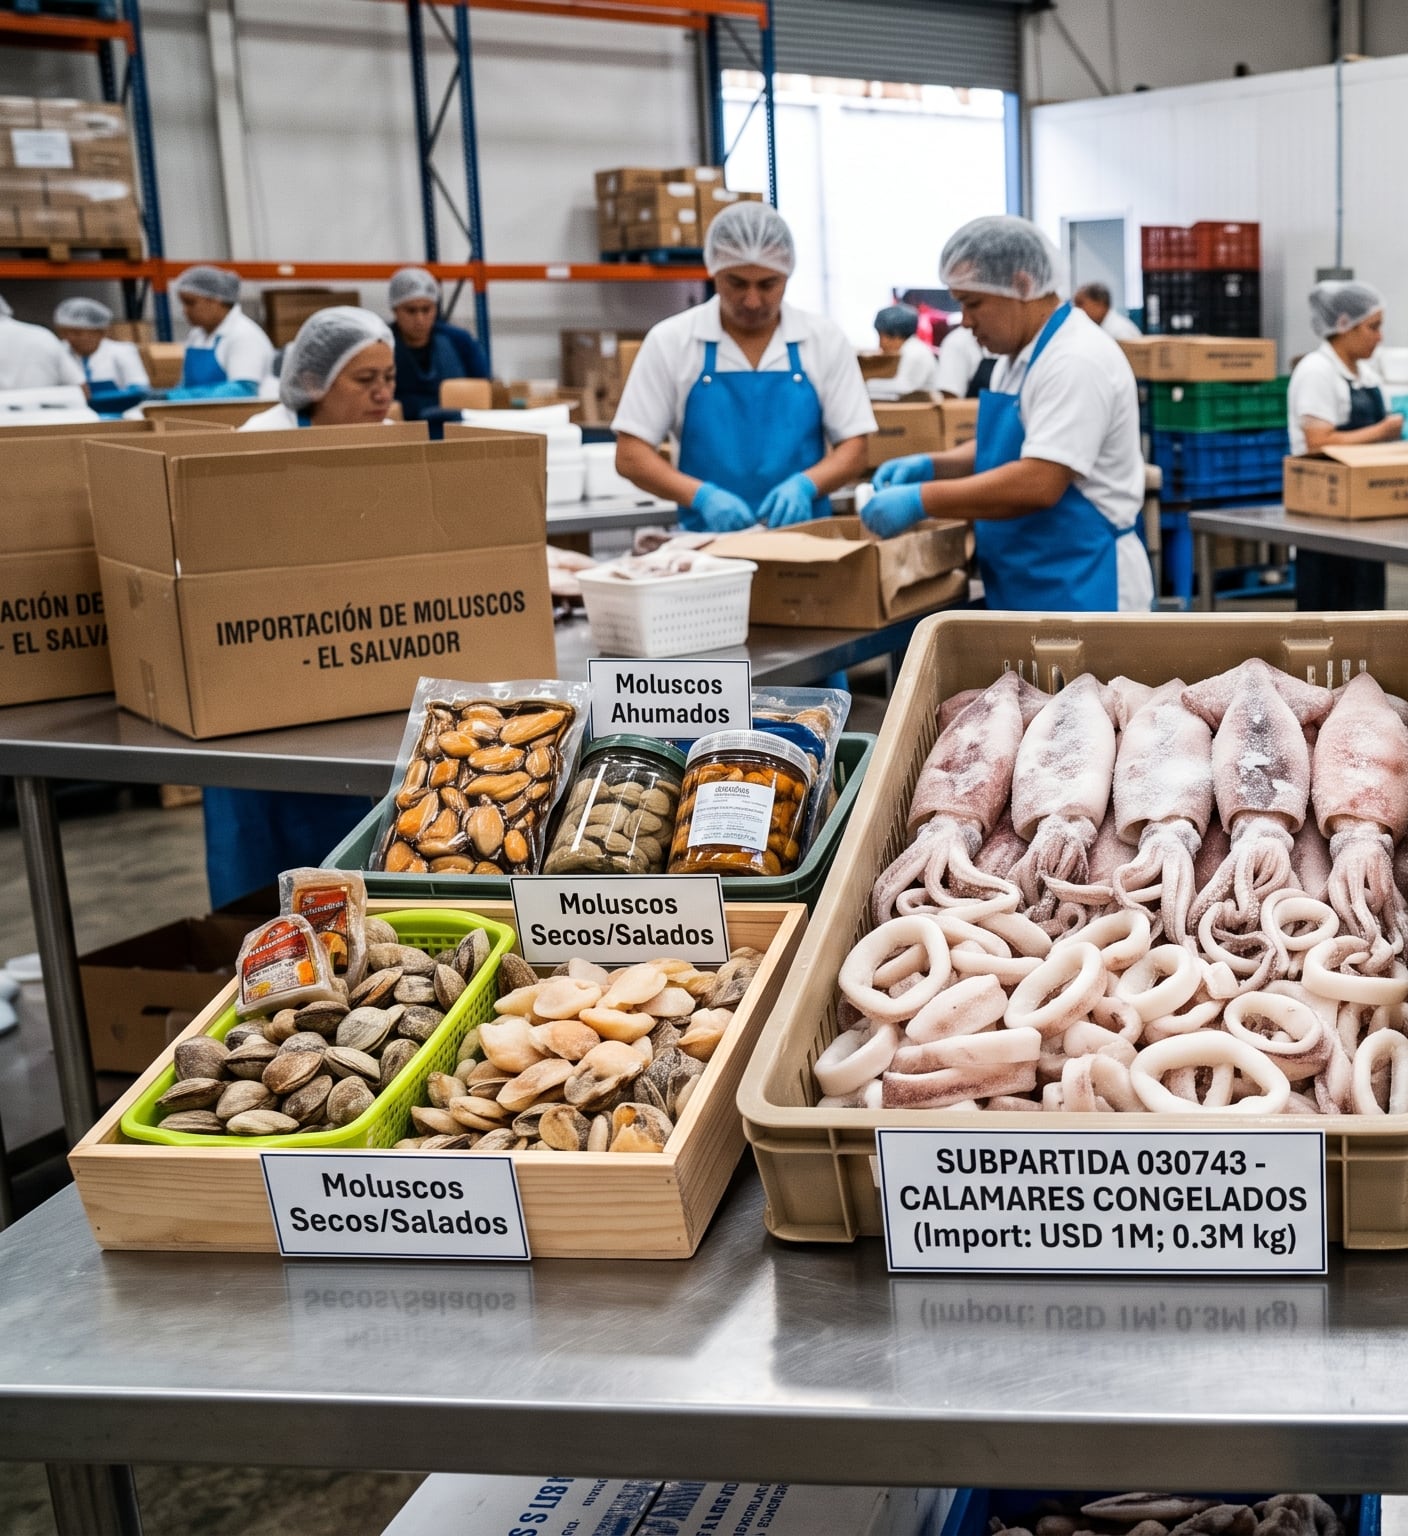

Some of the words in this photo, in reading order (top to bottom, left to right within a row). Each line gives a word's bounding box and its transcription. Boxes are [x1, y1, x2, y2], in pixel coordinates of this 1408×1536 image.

[75, 591, 105, 617] DE
[216, 602, 373, 647] IMPORTACIÓN
[379, 602, 408, 629] DE
[413, 589, 526, 625] MOLUSCOS
[12, 631, 41, 655] EL
[317, 645, 344, 670] EL
[349, 630, 461, 666] SALVADOR
[615, 673, 723, 695] Moluscos
[610, 702, 730, 724] Ahumados
[559, 892, 678, 915] Moluscos
[530, 922, 714, 946] Secos/Salados
[936, 1148, 1130, 1175] SUBPARTIDA
[1137, 1149, 1247, 1176] 030743
[321, 1172, 464, 1200] Moluscos
[899, 1185, 1085, 1212] CALAMARES
[1093, 1186, 1307, 1212] CONGELADOS
[289, 1206, 508, 1235] Secos/Salados
[913, 1222, 1032, 1254] (Import:
[1040, 1223, 1103, 1249] USD
[1111, 1223, 1164, 1253] 1M;
[1172, 1223, 1244, 1249] 0.3M
[1253, 1223, 1296, 1255] kg)
